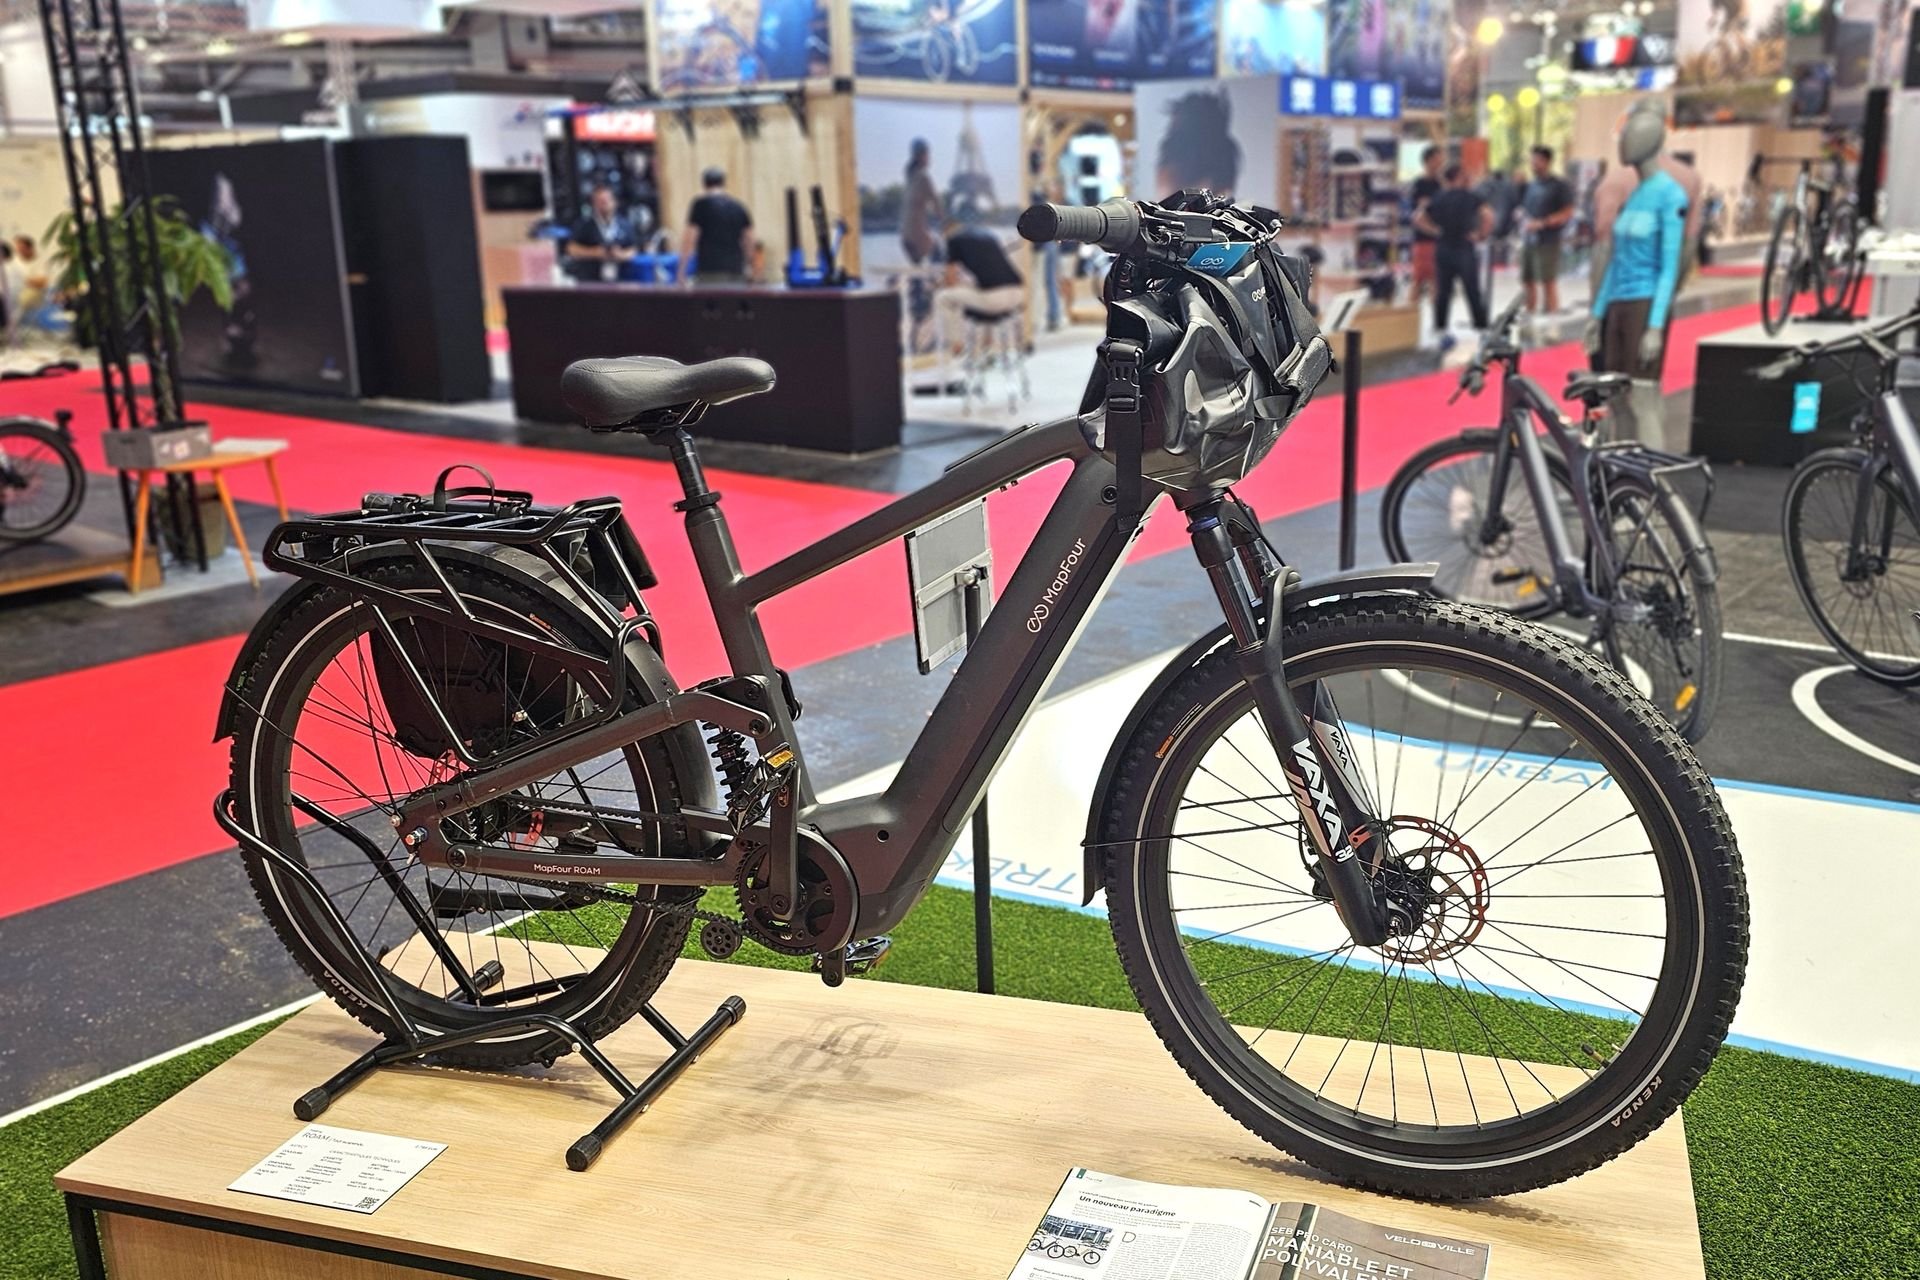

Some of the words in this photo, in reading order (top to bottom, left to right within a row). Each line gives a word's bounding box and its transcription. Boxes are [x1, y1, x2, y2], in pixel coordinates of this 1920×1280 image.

[1042, 537, 1086, 604] MapFour
[1330, 731, 1348, 770] VAXA
[1292, 737, 1342, 850] VAXA
[533, 863, 572, 874] MapFour
[574, 866, 601, 875] ROAM
[1335, 845, 1354, 863] 32
[323, 970, 368, 1009] KENDA
[1610, 1075, 1663, 1127] KENDA
[302, 1132, 331, 1141] ROAM
[1079, 1195, 1091, 1203] Un
[1092, 1198, 1129, 1210] nouveau
[1130, 1205, 1176, 1217] paradigme
[1267, 1236, 1380, 1274] MANIABLE
[1385, 1263, 1414, 1279] ET
[1270, 1227, 1294, 1235] SEB
[1295, 1229, 1320, 1242] PRO
[1321, 1238, 1353, 1253] CARO
